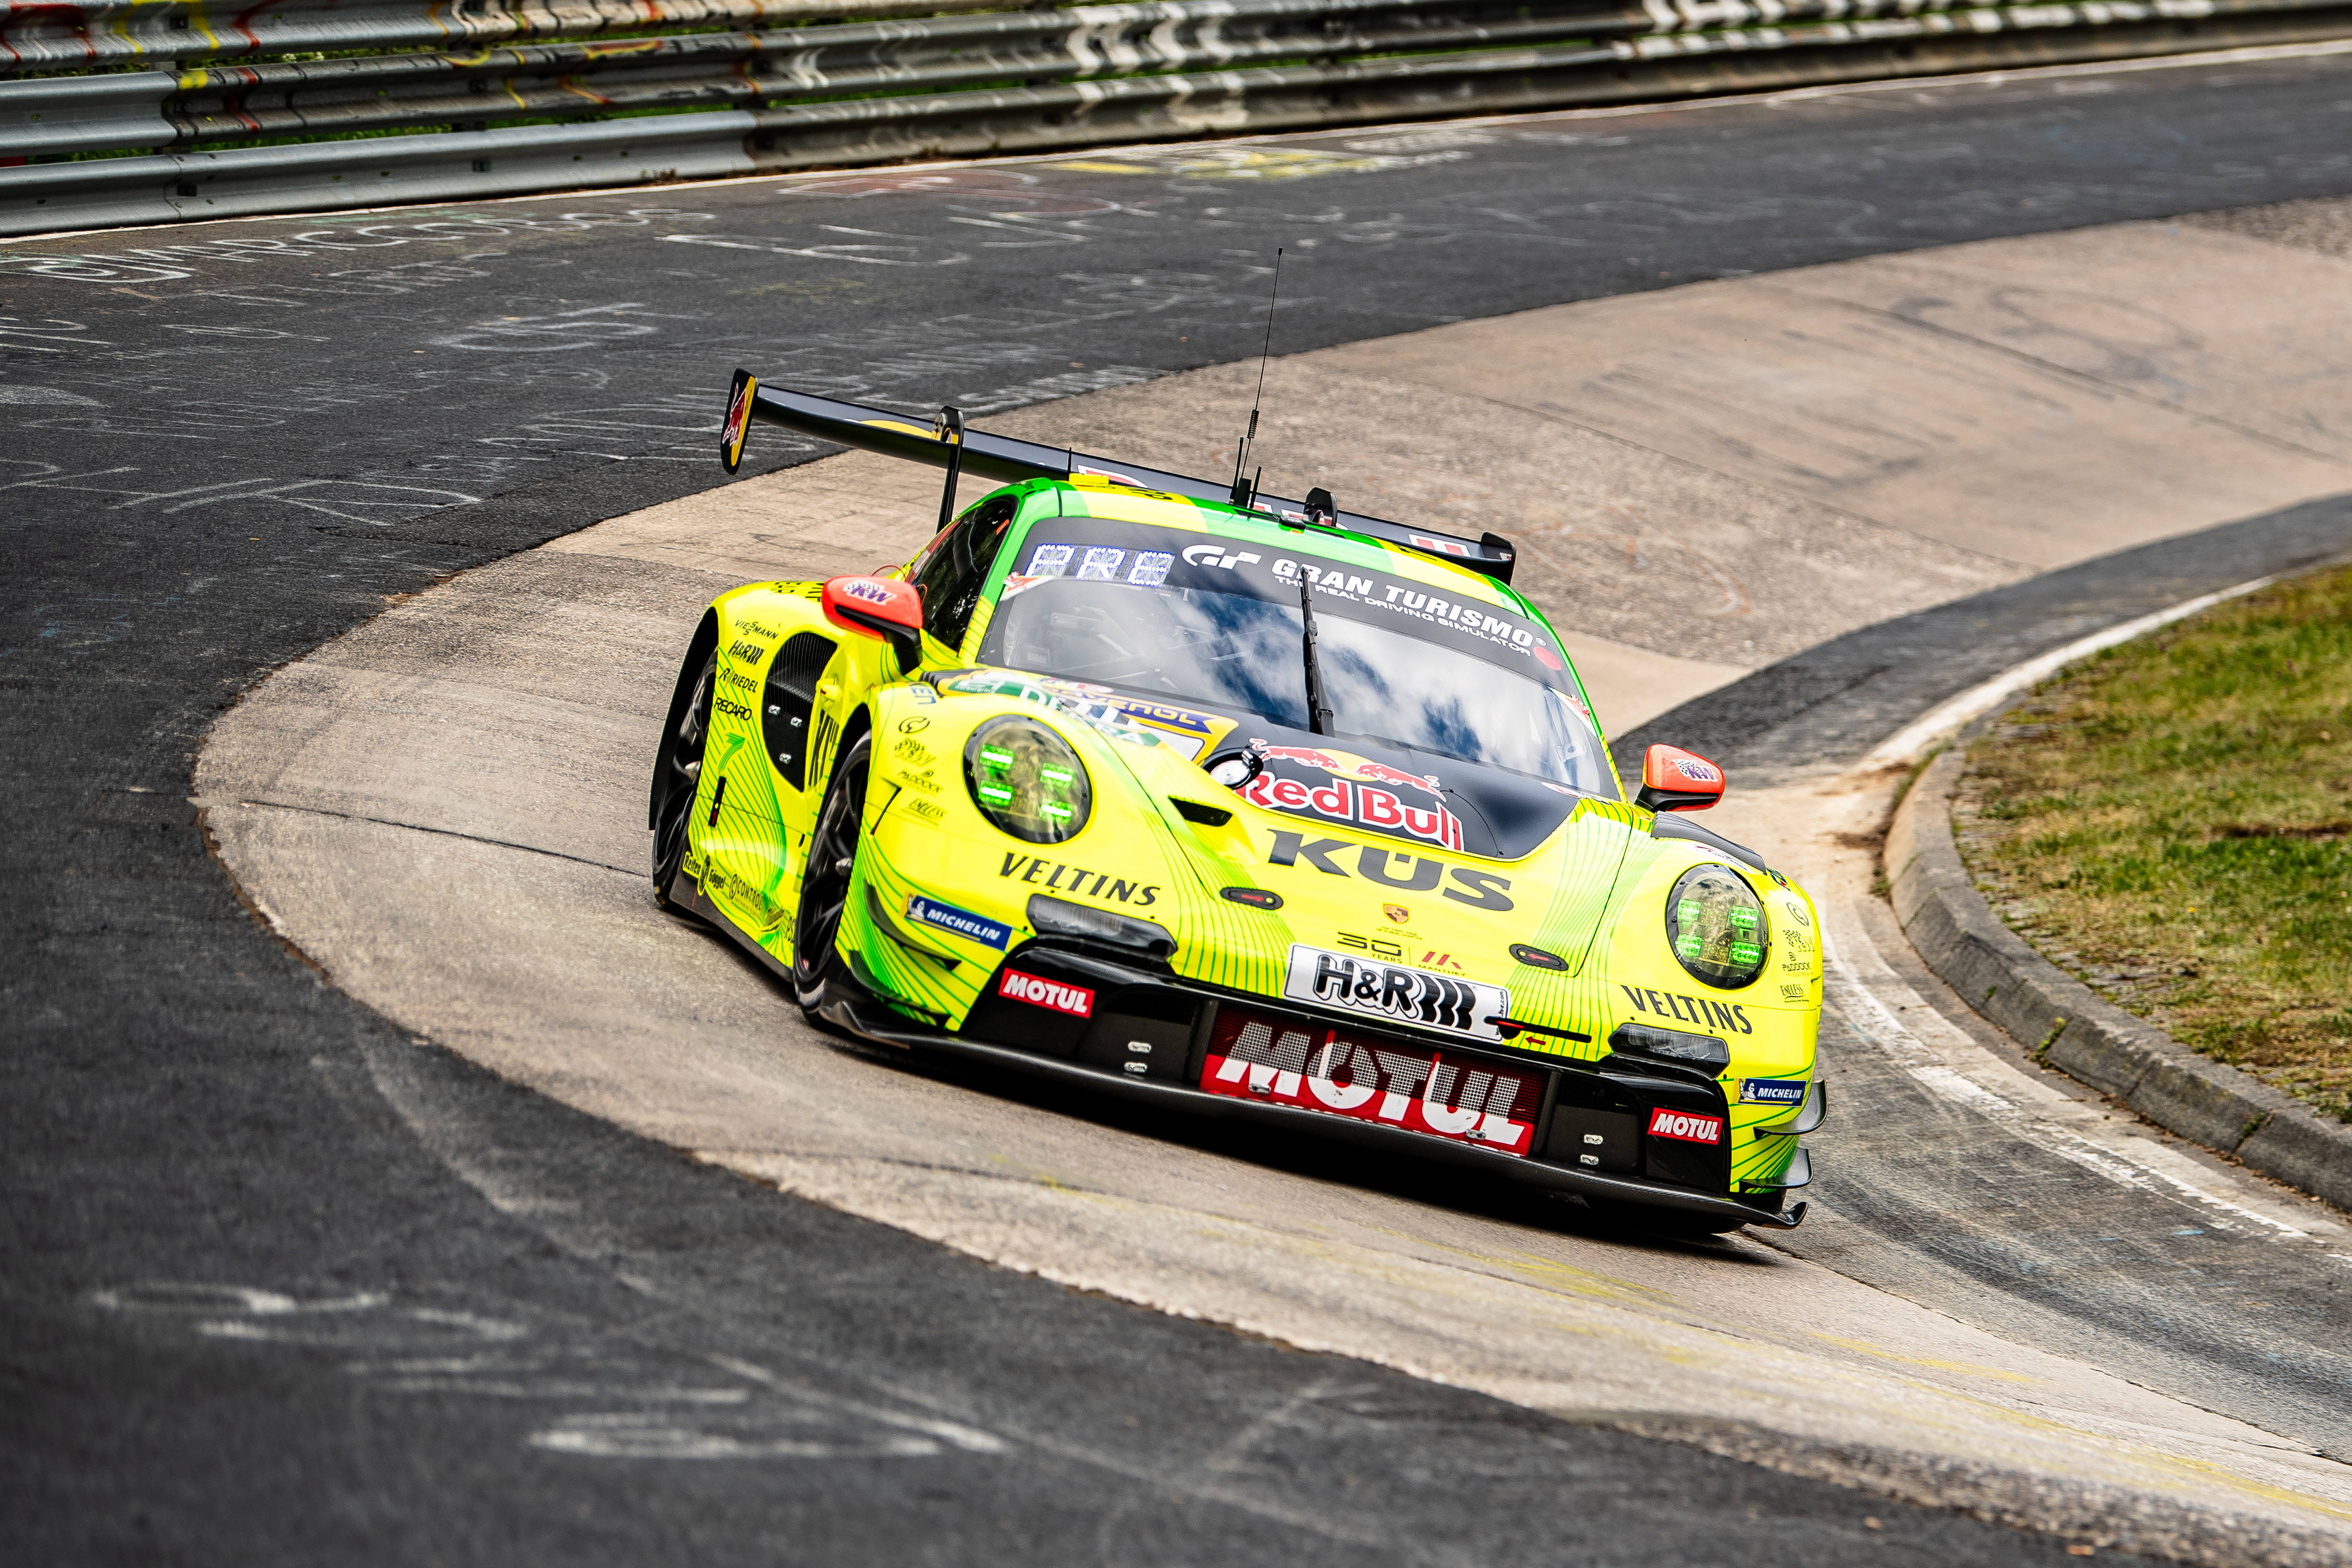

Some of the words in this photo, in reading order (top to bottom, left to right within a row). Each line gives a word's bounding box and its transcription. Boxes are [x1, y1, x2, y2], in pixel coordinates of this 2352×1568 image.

[1271, 558, 1374, 596] GRAN
[1315, 584, 1361, 602] REAL
[1364, 596, 1435, 622] DRIVING
[1437, 617, 1532, 657] SIMULATOR
[730, 674, 758, 693] RIEDEL
[713, 697, 753, 721] RECARO
[1234, 770, 1352, 819] Red
[1358, 785, 1464, 851] Bull
[684, 854, 701, 876] Reifen
[998, 851, 1161, 907] VELTINS
[927, 908, 1001, 941] MICHELIN
[1336, 932, 1402, 956] 30
[1371, 953, 1403, 964] YEARS
[1418, 964, 1467, 977] MANTHEY
[1781, 962, 1812, 972] PADDOCK
[1002, 974, 1089, 1014] MOTUL
[1780, 984, 1804, 996] ENDLESS
[1620, 984, 1754, 1035] VELTINS
[1215, 1021, 1526, 1147] MOTUL
[1757, 1087, 1803, 1100] MICHELIN
[1652, 1113, 1719, 1142] MOTUL
